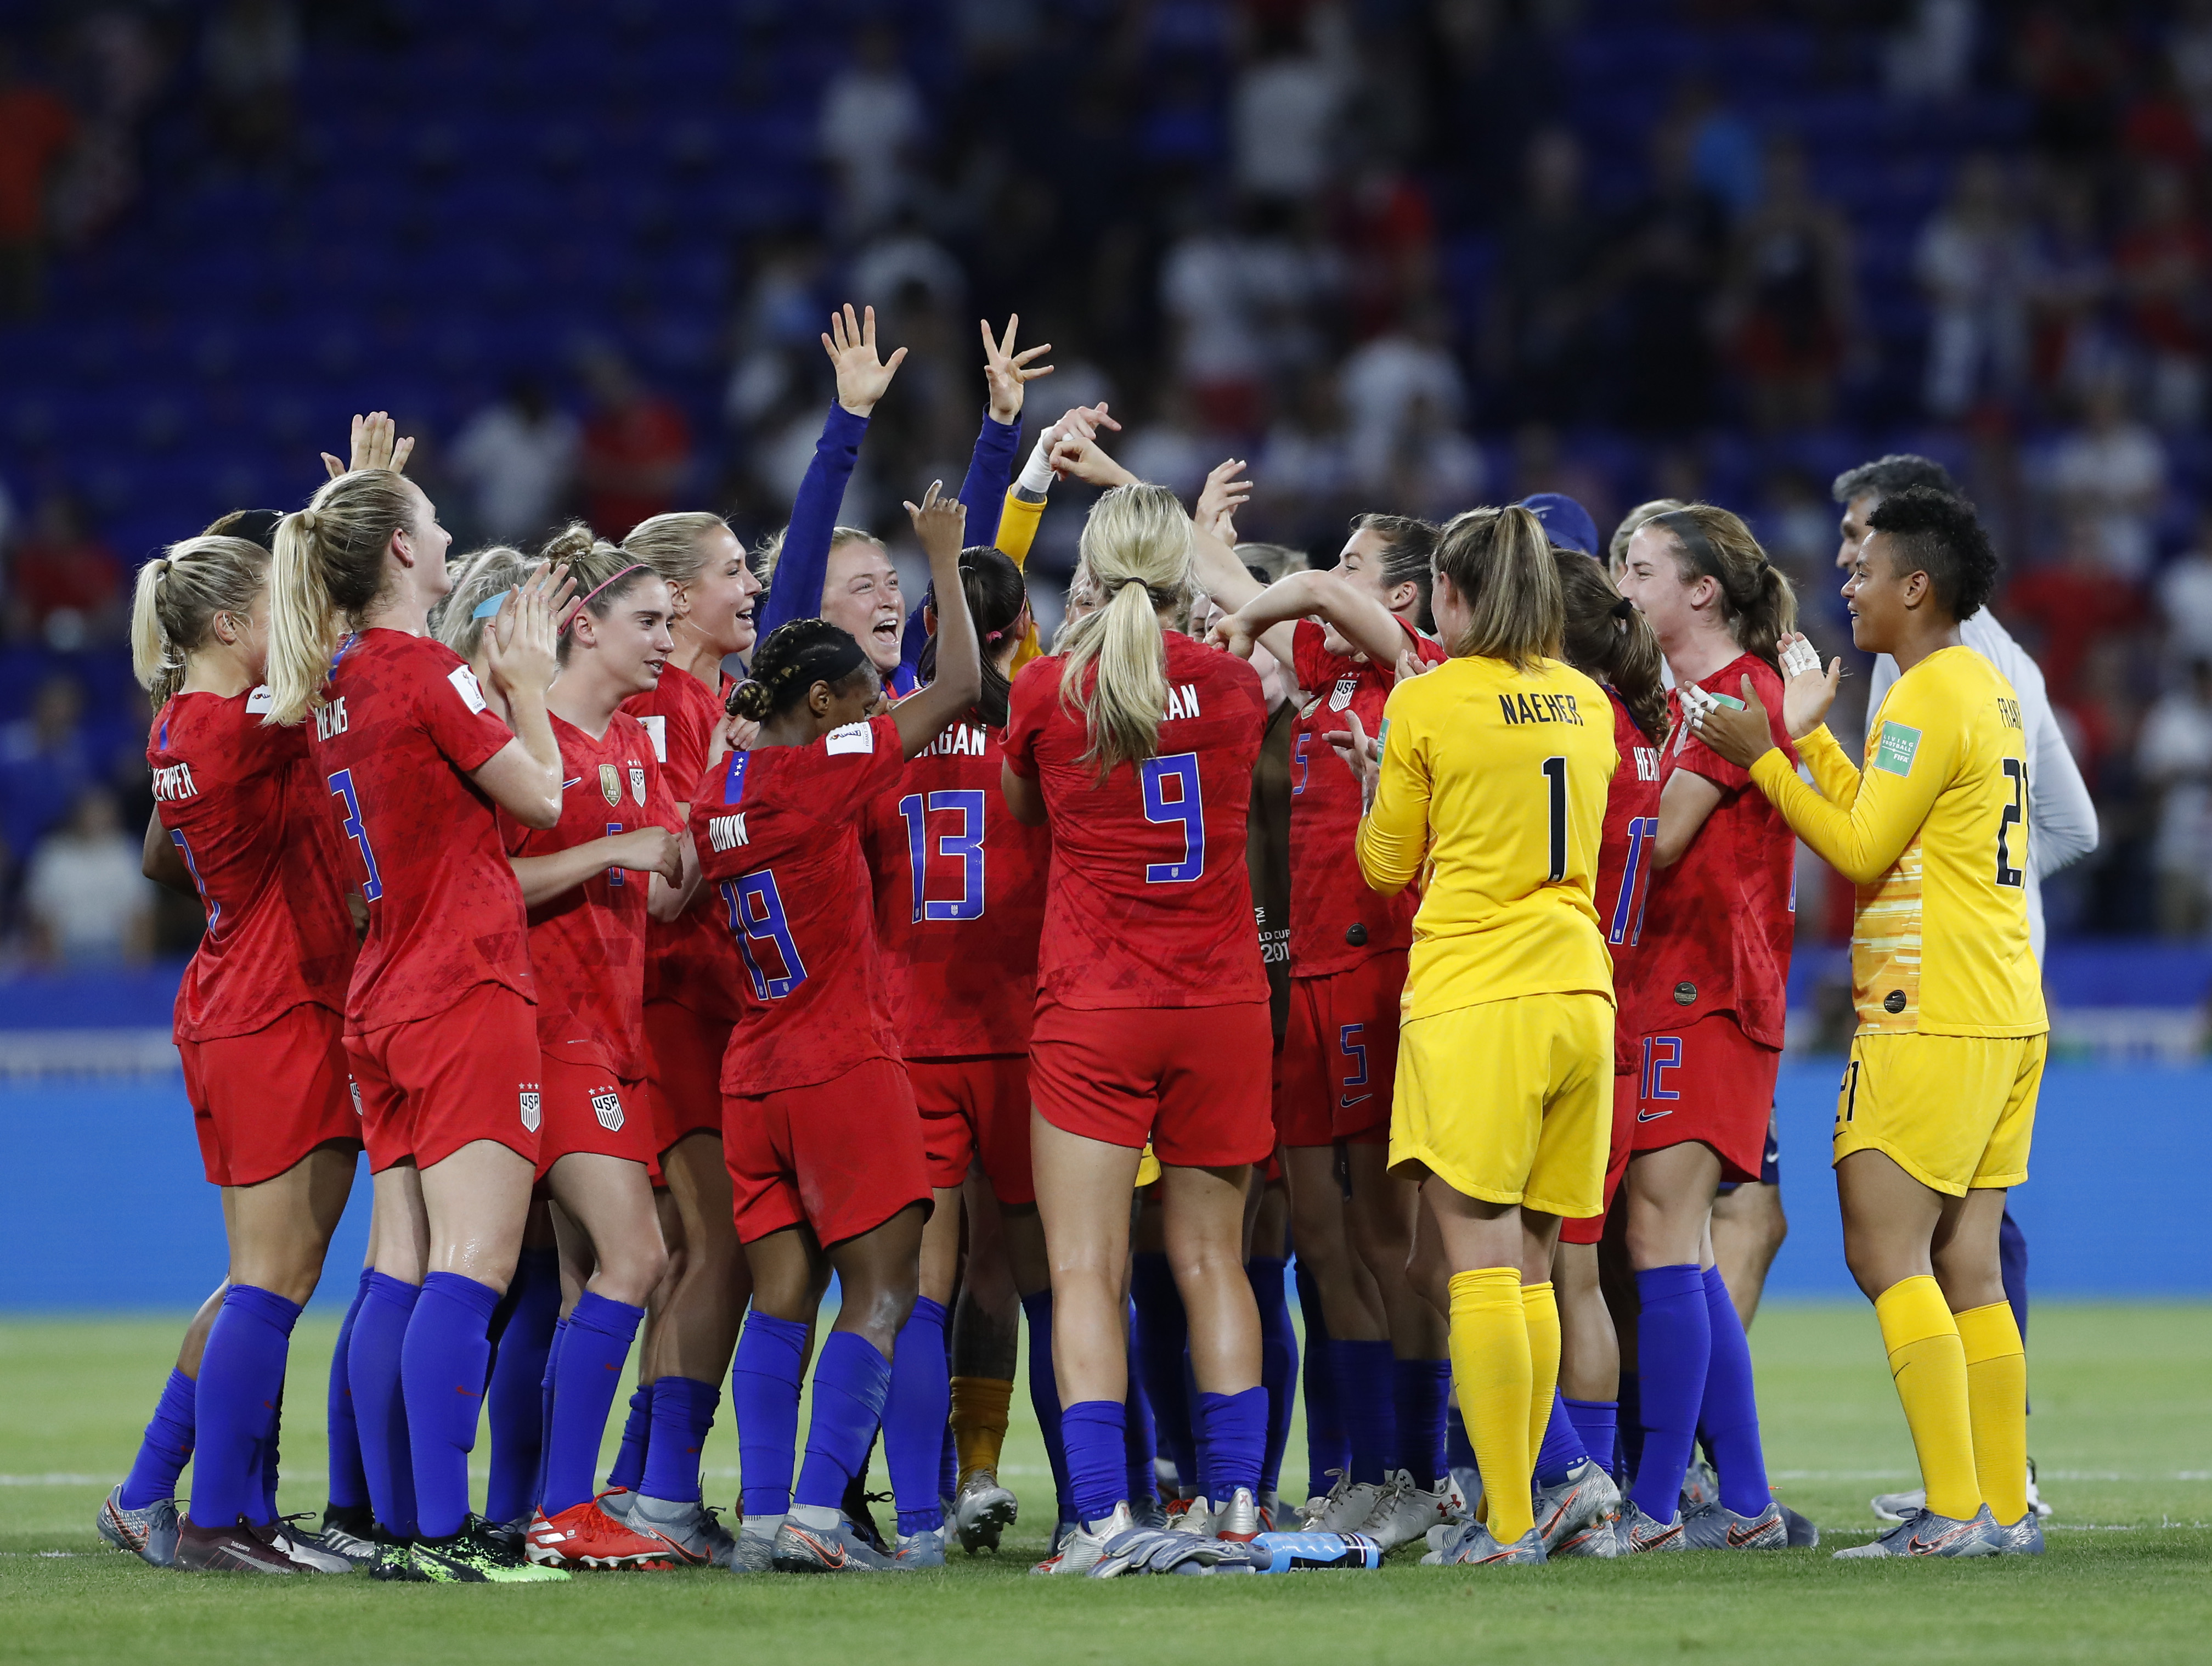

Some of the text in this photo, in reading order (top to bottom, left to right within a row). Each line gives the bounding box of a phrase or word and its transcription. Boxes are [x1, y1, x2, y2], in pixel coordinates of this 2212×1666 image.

[314, 696, 348, 742] MEWIS
[1163, 684, 1200, 721] AN
[1498, 694, 1584, 726] NAEHER
[1882, 739, 1912, 752] FOOTBALL
[1883, 734, 1914, 747] LIVING
[1893, 753, 1908, 763] FIFA
[1293, 733, 1312, 795] 5
[328, 768, 382, 903] 3
[709, 812, 749, 853] DUNN
[1141, 752, 1205, 883] 9
[1542, 756, 1567, 882] 1
[899, 789, 985, 924] 13
[720, 869, 808, 1001] 19
[1260, 941, 1290, 964] 201
[1340, 1023, 1368, 1086] 5
[1640, 1037, 1682, 1100] 12
[522, 1095, 539, 1110] USA
[595, 1096, 617, 1111] USA
